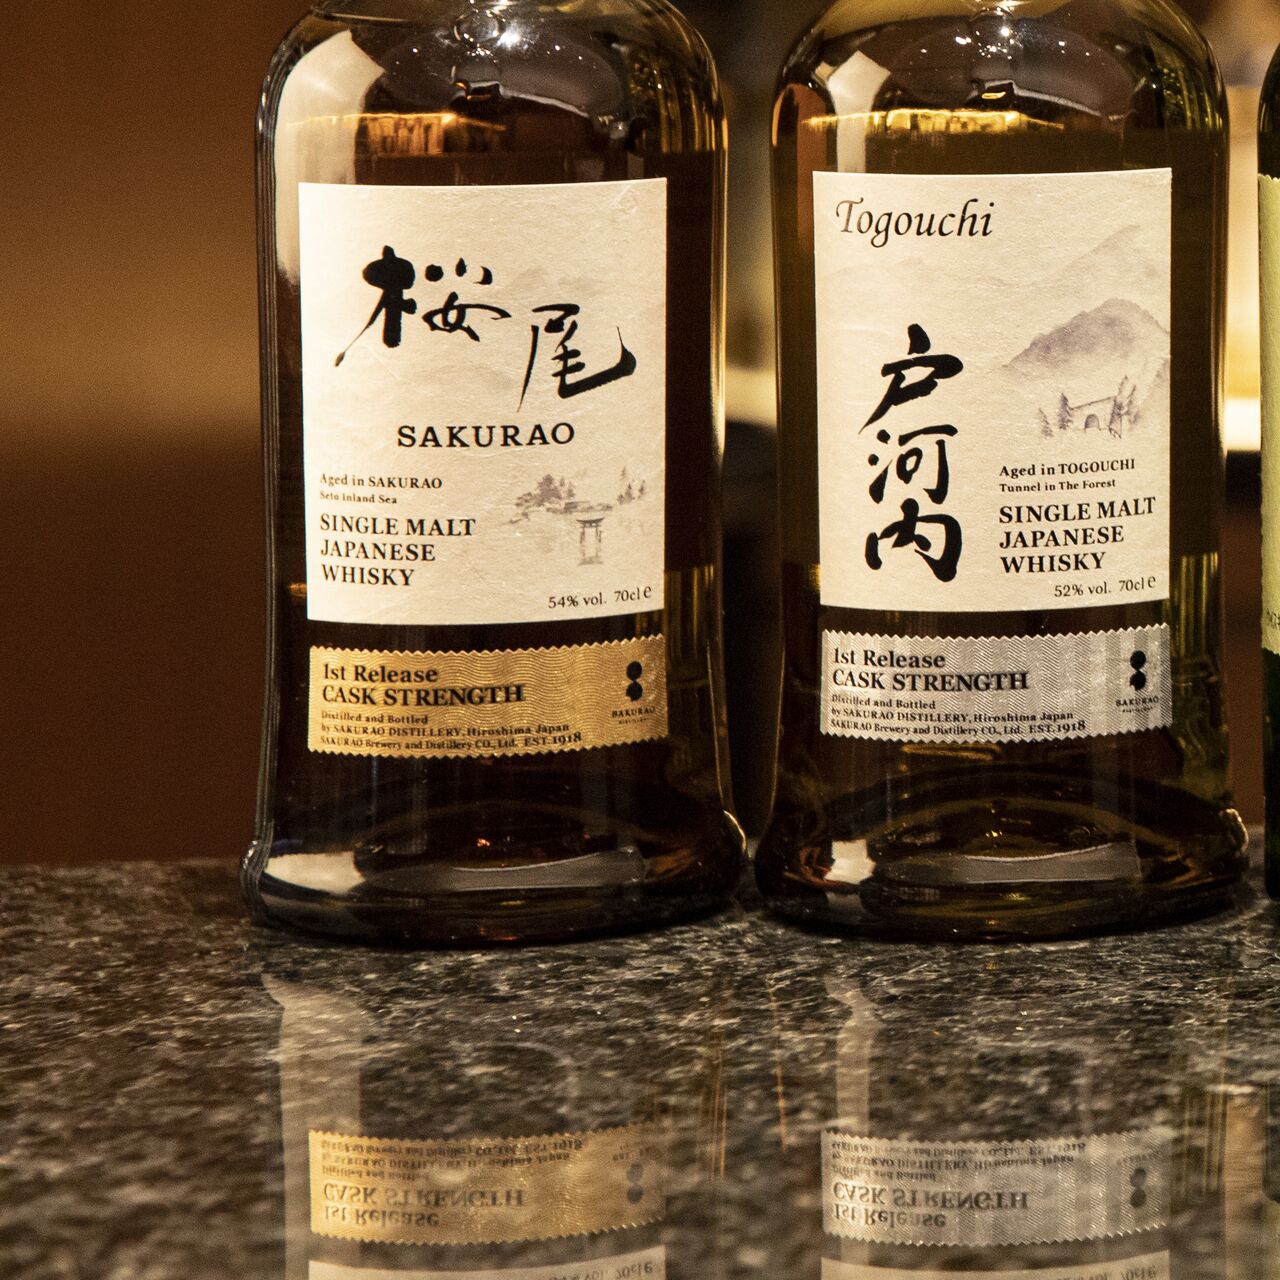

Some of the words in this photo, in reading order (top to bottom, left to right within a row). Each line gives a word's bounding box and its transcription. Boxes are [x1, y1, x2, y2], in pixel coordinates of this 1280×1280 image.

[835, 197, 994, 248] Togouchi
[335, 245, 636, 411] 桜尾
[397, 422, 575, 448] SAKURAO
[1000, 464, 1035, 479] Aged
[1041, 464, 1055, 476] in
[1058, 458, 1135, 474] TOGOUCHI
[320, 474, 347, 487] Aged
[353, 475, 364, 486] in
[368, 476, 442, 488] SAKURAO
[1000, 483, 1040, 492] Tunnel
[1045, 482, 1055, 491] in
[1059, 481, 1079, 490] The
[1083, 479, 1116, 489] Forest
[378, 495, 397, 503] Sea
[999, 503, 1091, 523] SINGLE
[1097, 497, 1156, 519] MALT
[320, 514, 398, 535] SINGLE
[406, 519, 476, 536] MALT
[999, 526, 1124, 549] JAPANESE
[321, 539, 435, 561] JAPANESE
[1000, 552, 1106, 574] WHISKY
[322, 564, 415, 585] WHISKY
[1054, 584, 1083, 597] 52%
[1088, 581, 1111, 595] vol.
[548, 595, 578, 608] 54%
[583, 592, 606, 605] vol.
[834, 648, 855, 664] 1st
[863, 649, 945, 668] Release
[324, 663, 345, 680] 1st
[354, 665, 438, 683] Release
[832, 669, 885, 690] CASK
[892, 671, 1029, 692] STRENGTH
[323, 684, 376, 705] CASK
[384, 684, 525, 706] STRENGTH
[832, 695, 870, 706] Distilled
[874, 698, 892, 707] and
[896, 699, 935, 709] Bottled
